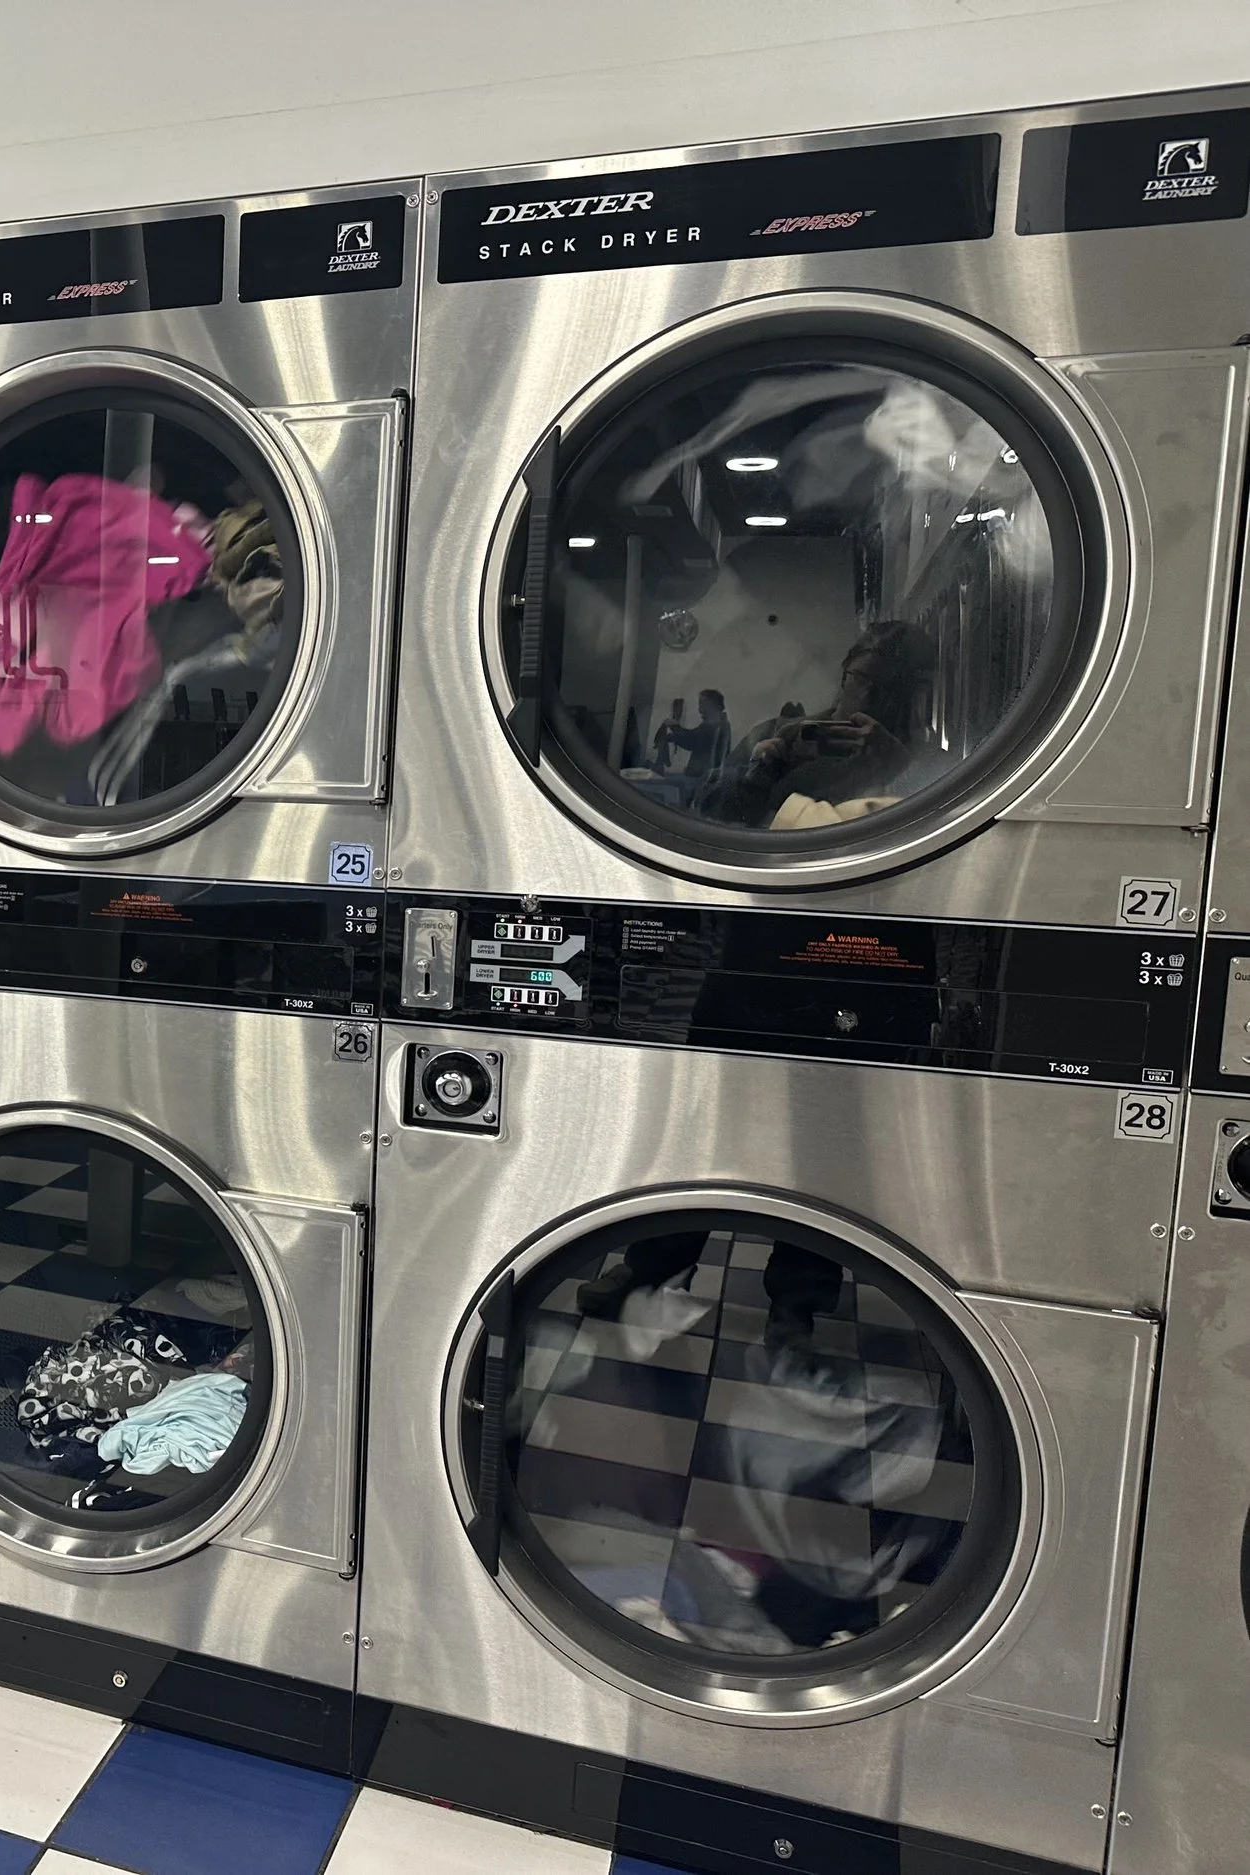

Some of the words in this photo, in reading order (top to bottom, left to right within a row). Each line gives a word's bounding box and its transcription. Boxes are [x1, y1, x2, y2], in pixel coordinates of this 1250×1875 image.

[1143, 176, 1216, 191] DEXTER
[1142, 186, 1218, 200] LAUNDRY
[480, 191, 654, 226] DEXTER
[762, 211, 863, 235] EXPRESS
[478, 238, 576, 260] STACK
[601, 226, 701, 249] DRYER
[328, 252, 379, 264] DEXTER
[328, 260, 381, 273] LAUNDRY
[56, 280, 129, 300] EXPRESS
[336, 854, 366, 876] 25
[1126, 890, 1170, 917] 27
[346, 905, 353, 917] 3
[356, 910, 363, 918] x
[345, 921, 353, 932] 3
[356, 925, 363, 933] x
[438, 922, 453, 931] Only
[838, 936, 880, 944] WARNING
[1140, 952, 1152, 966] 3
[1156, 956, 1165, 966] x
[530, 971, 552, 982] 600
[1139, 971, 1150, 985] 3
[1154, 975, 1163, 985] x
[284, 998, 314, 1009] T-30X2
[338, 1032, 368, 1054] 26
[1049, 1062, 1090, 1075] T-30X2
[1124, 1102, 1166, 1130] 28
